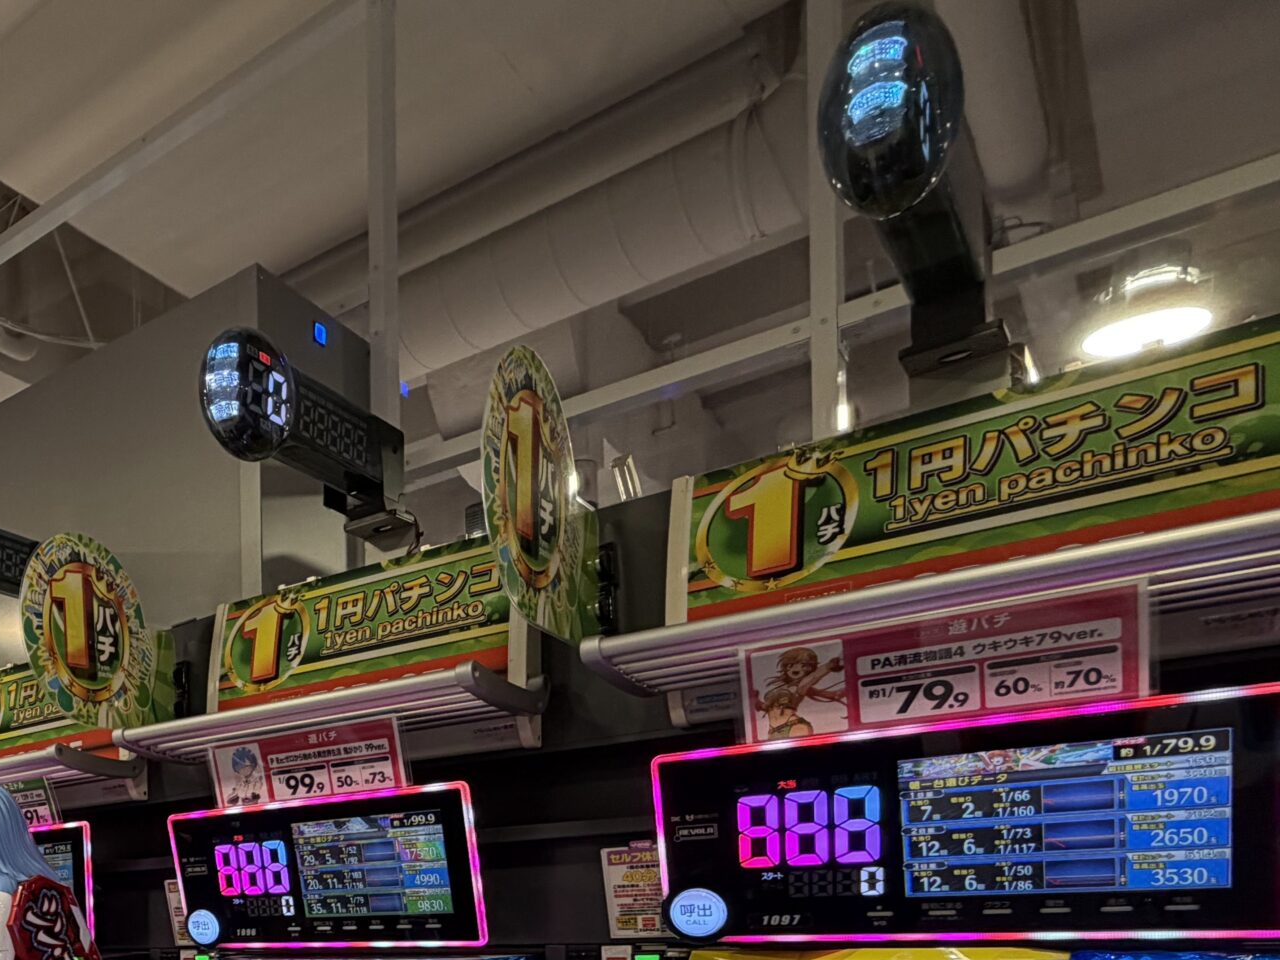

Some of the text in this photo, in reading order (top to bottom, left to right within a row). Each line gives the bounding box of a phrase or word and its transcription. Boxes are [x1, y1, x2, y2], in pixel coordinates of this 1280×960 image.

[865, 362, 1265, 499] 1円パチンコ
[888, 425, 1231, 526] 1yen pachinko
[726, 462, 846, 579] 1 パチ
[314, 563, 503, 632] 1円パチンコ
[49, 567, 116, 670] 1 パチ
[324, 598, 485, 649] 1yen pachinko
[947, 613, 1013, 636] 遊パチ
[241, 601, 303, 682] 1 パチ
[972, 626, 1104, 655] ウキウキ79ver.
[993, 676, 1044, 698] 60%
[1142, 735, 1217, 756] 1/79.9
[278, 773, 325, 796] 1/99.9
[403, 813, 436, 826] 1/99.9
[609, 851, 659, 864] セルフ休
[679, 902, 714, 919] 呼出
[762, 914, 802, 927] 1097
[685, 919, 710, 927] CALL
